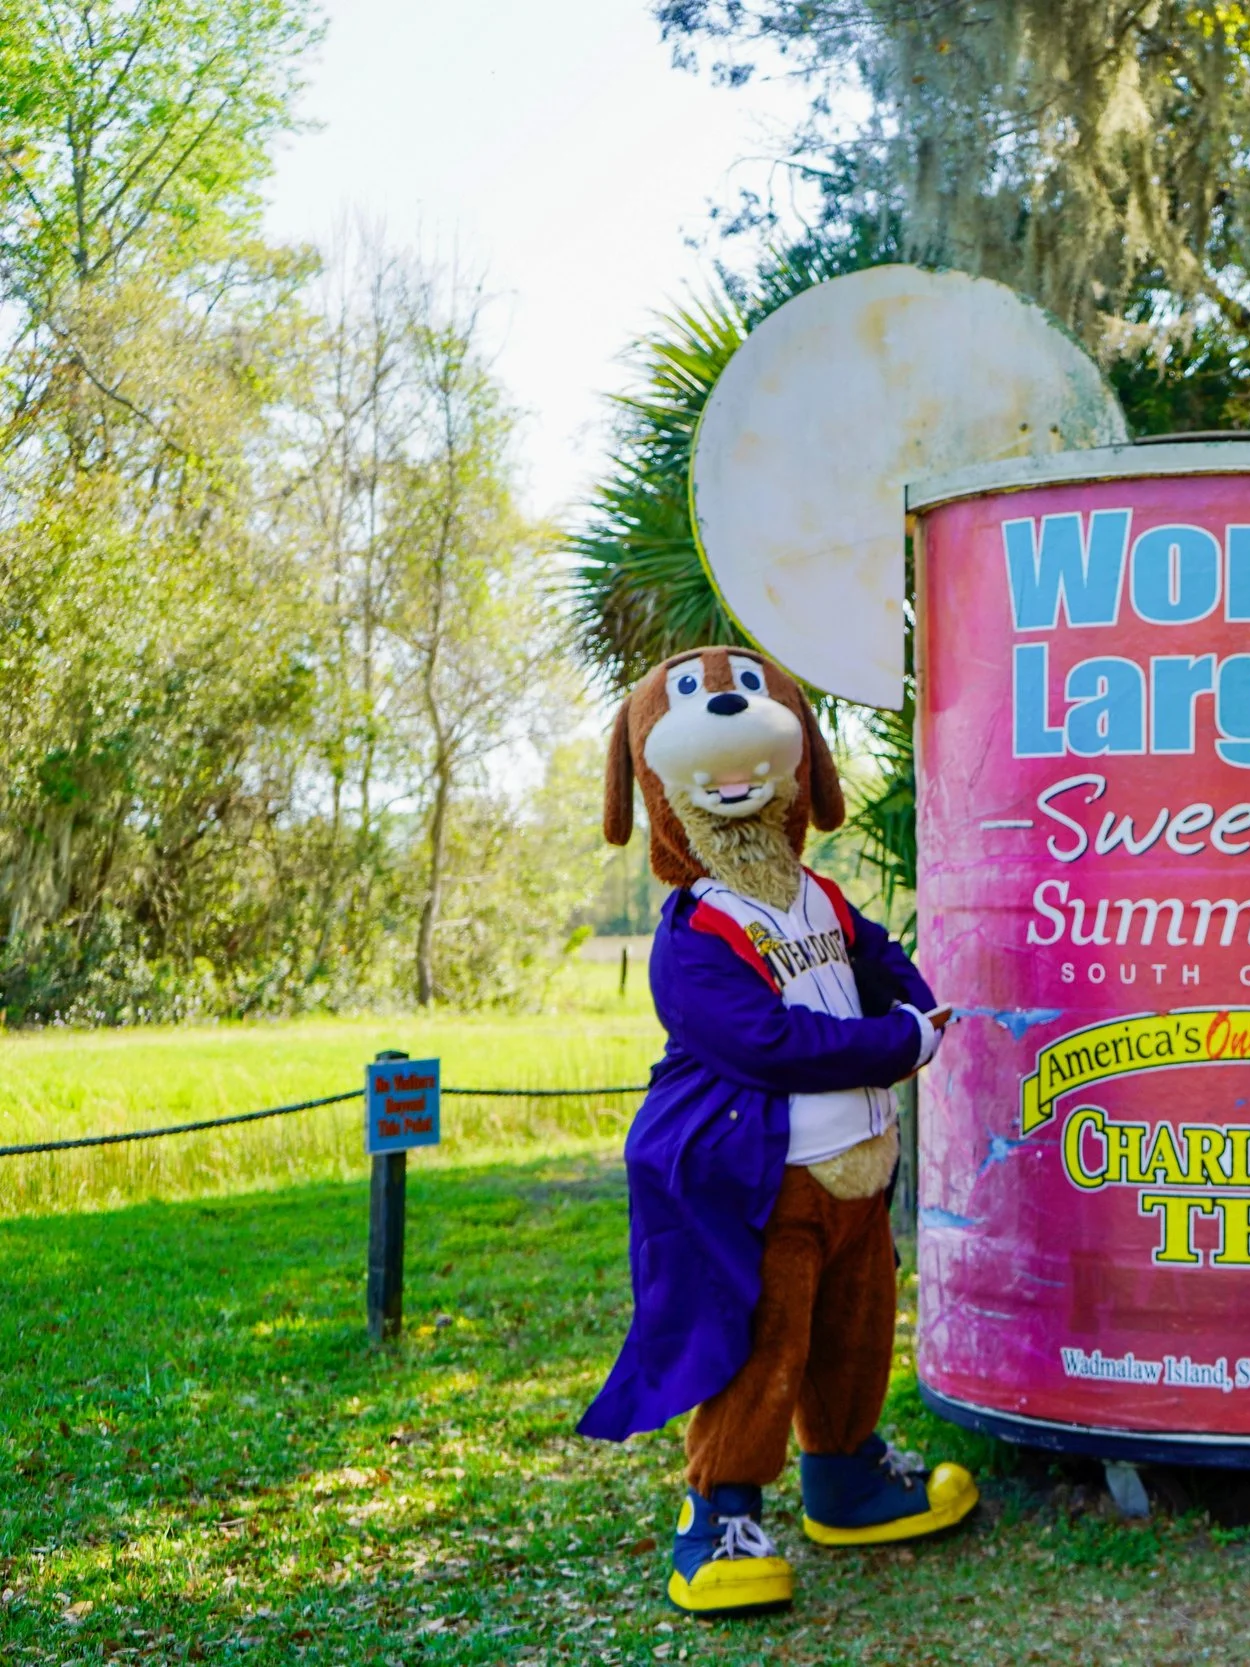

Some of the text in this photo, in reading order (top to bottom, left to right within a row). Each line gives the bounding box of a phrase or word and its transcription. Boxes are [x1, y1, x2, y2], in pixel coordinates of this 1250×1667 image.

[1061, 963, 1202, 987] SOUTH
[1049, 1023, 1201, 1087] America's
[1061, 1347, 1163, 1384] Wadmalaw
[1163, 1355, 1234, 1393] Island,
